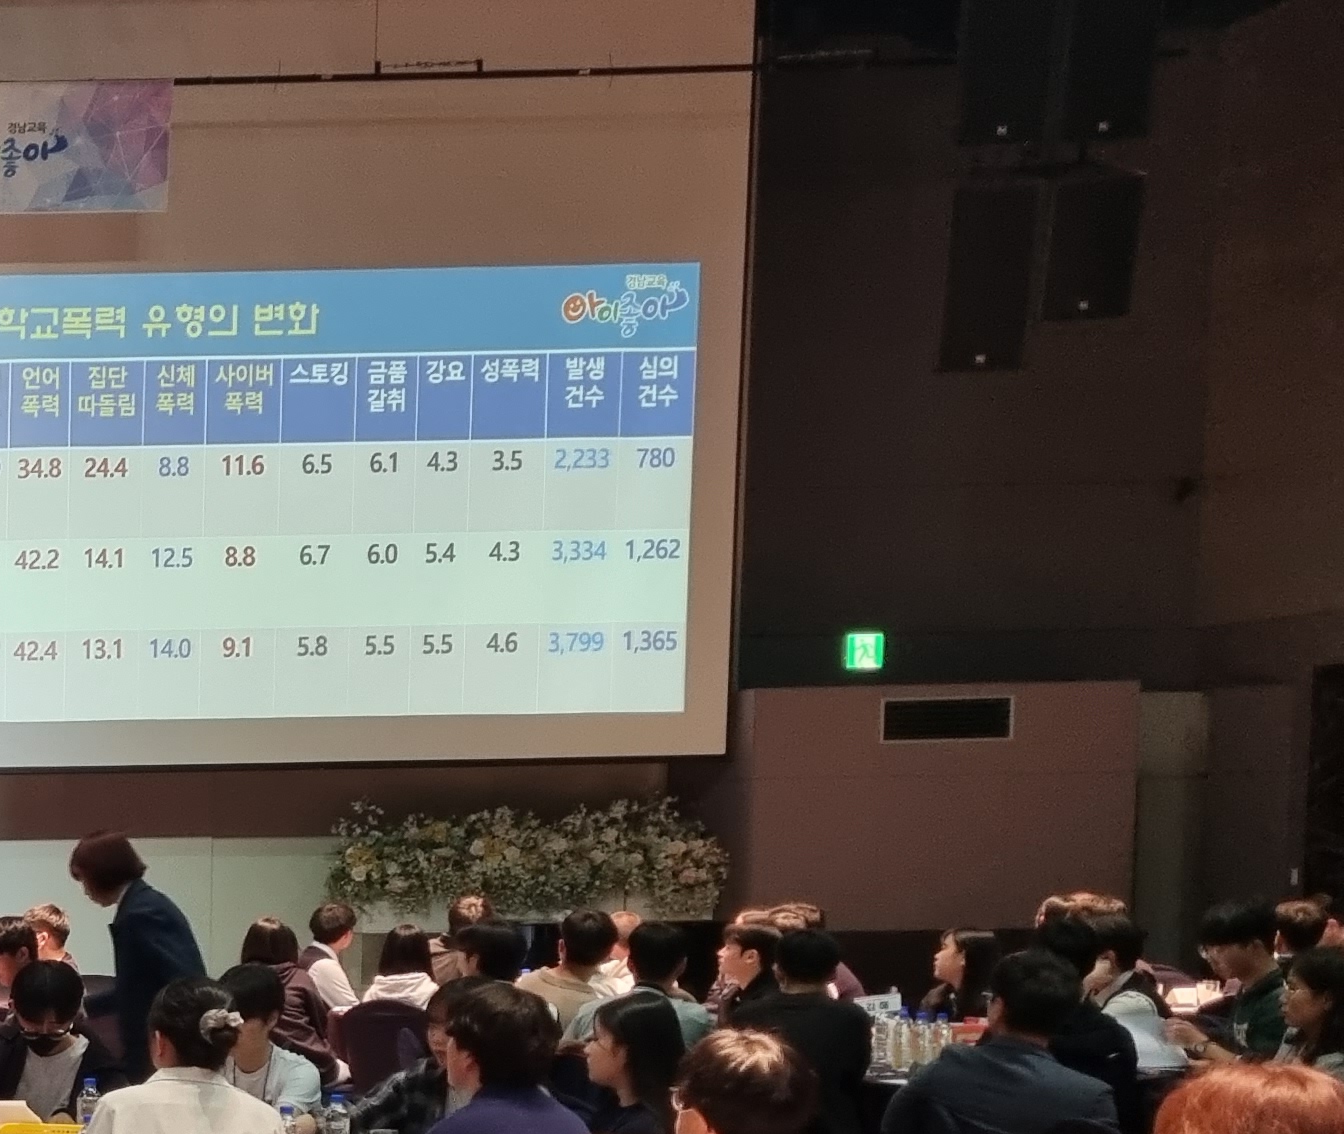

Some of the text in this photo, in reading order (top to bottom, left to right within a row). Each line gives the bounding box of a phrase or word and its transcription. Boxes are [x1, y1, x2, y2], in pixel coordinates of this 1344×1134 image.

[143, 304, 238, 337] 유형의
[255, 302, 319, 335] 변화
[23, 367, 59, 389] 언어
[89, 366, 127, 389] 집단
[158, 364, 195, 387] 신체
[215, 363, 273, 387] 사이버
[290, 362, 348, 385] 스토킹
[368, 361, 407, 384] 금품
[426, 360, 465, 383] 강요
[481, 358, 539, 382] 성폭력
[566, 357, 604, 380] 발생
[640, 355, 678, 379] 심의
[21, 394, 59, 417] 폭력
[78, 394, 135, 417] 따돌림
[156, 392, 193, 415] 폭력
[225, 391, 262, 414] 폭력
[368, 388, 405, 412] 갈취
[565, 385, 604, 408] 건수
[639, 384, 678, 407] 건수
[18, 458, 61, 478] 34.8
[85, 458, 128, 477] 24.4
[159, 457, 189, 476] 8.8
[222, 455, 264, 476] 11.6
[303, 454, 331, 474] 6.5
[370, 452, 397, 472] 6.1
[427, 451, 457, 471] 4.3
[492, 451, 522, 470] 3.5
[555, 448, 609, 471] 2,233
[637, 447, 675, 468] 780
[15, 549, 59, 569] 42.2
[85, 548, 122, 568] 14.1
[152, 548, 192, 567] 12.5
[226, 546, 255, 567] 8.8
[300, 545, 330, 565] 6.7
[368, 544, 397, 564] 6.0
[426, 543, 456, 563] 5.4
[489, 541, 519, 561] 4.3
[552, 541, 606, 563] 3,334
[626, 539, 680, 562] 1,262
[14, 641, 57, 661] 42.4
[83, 639, 121, 659] 13.1
[150, 639, 191, 658] 14.0
[223, 637, 250, 657] 9.1
[297, 636, 327, 656] 5.8
[366, 635, 394, 655] 5.5
[423, 634, 452, 654] 5.5
[487, 632, 517, 652] 4.6
[549, 632, 604, 655] 3,799
[624, 630, 677, 653] 1,365
